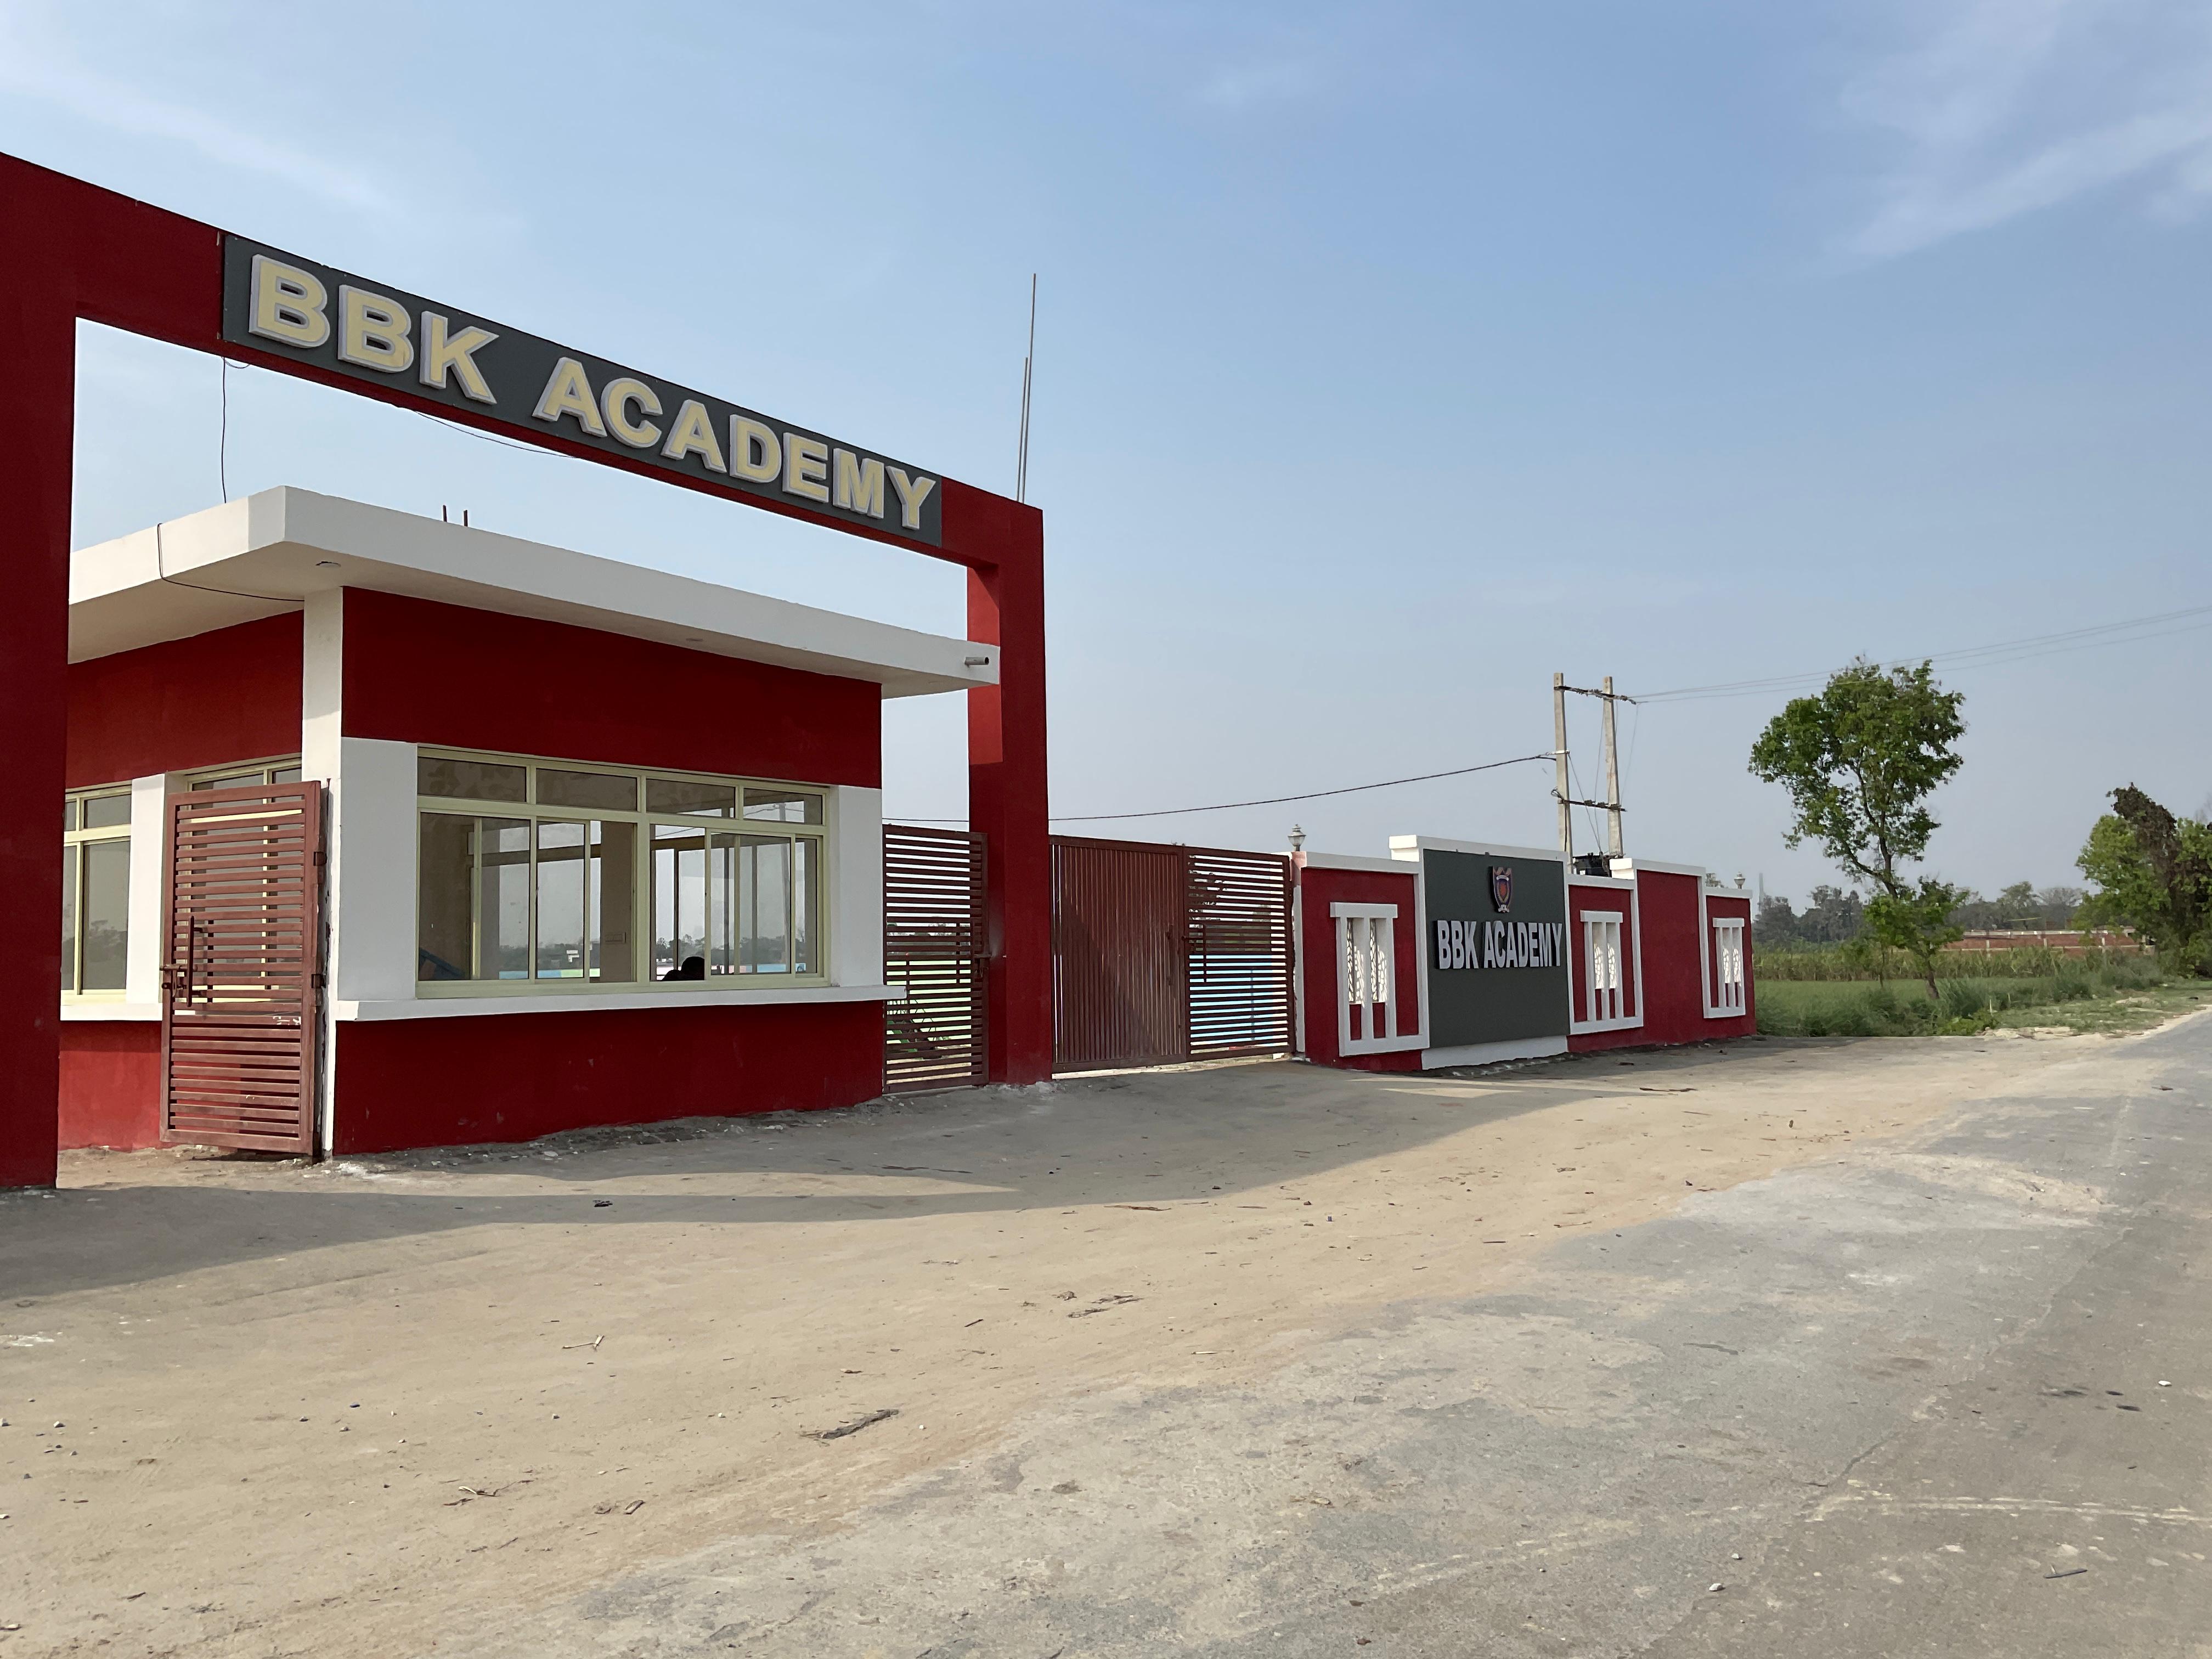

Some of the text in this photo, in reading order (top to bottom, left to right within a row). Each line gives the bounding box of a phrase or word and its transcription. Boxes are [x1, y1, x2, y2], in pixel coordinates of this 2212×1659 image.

[249, 253, 936, 530] BBK ACADEMY
[1437, 919, 1562, 969] BBK ACADEMY
